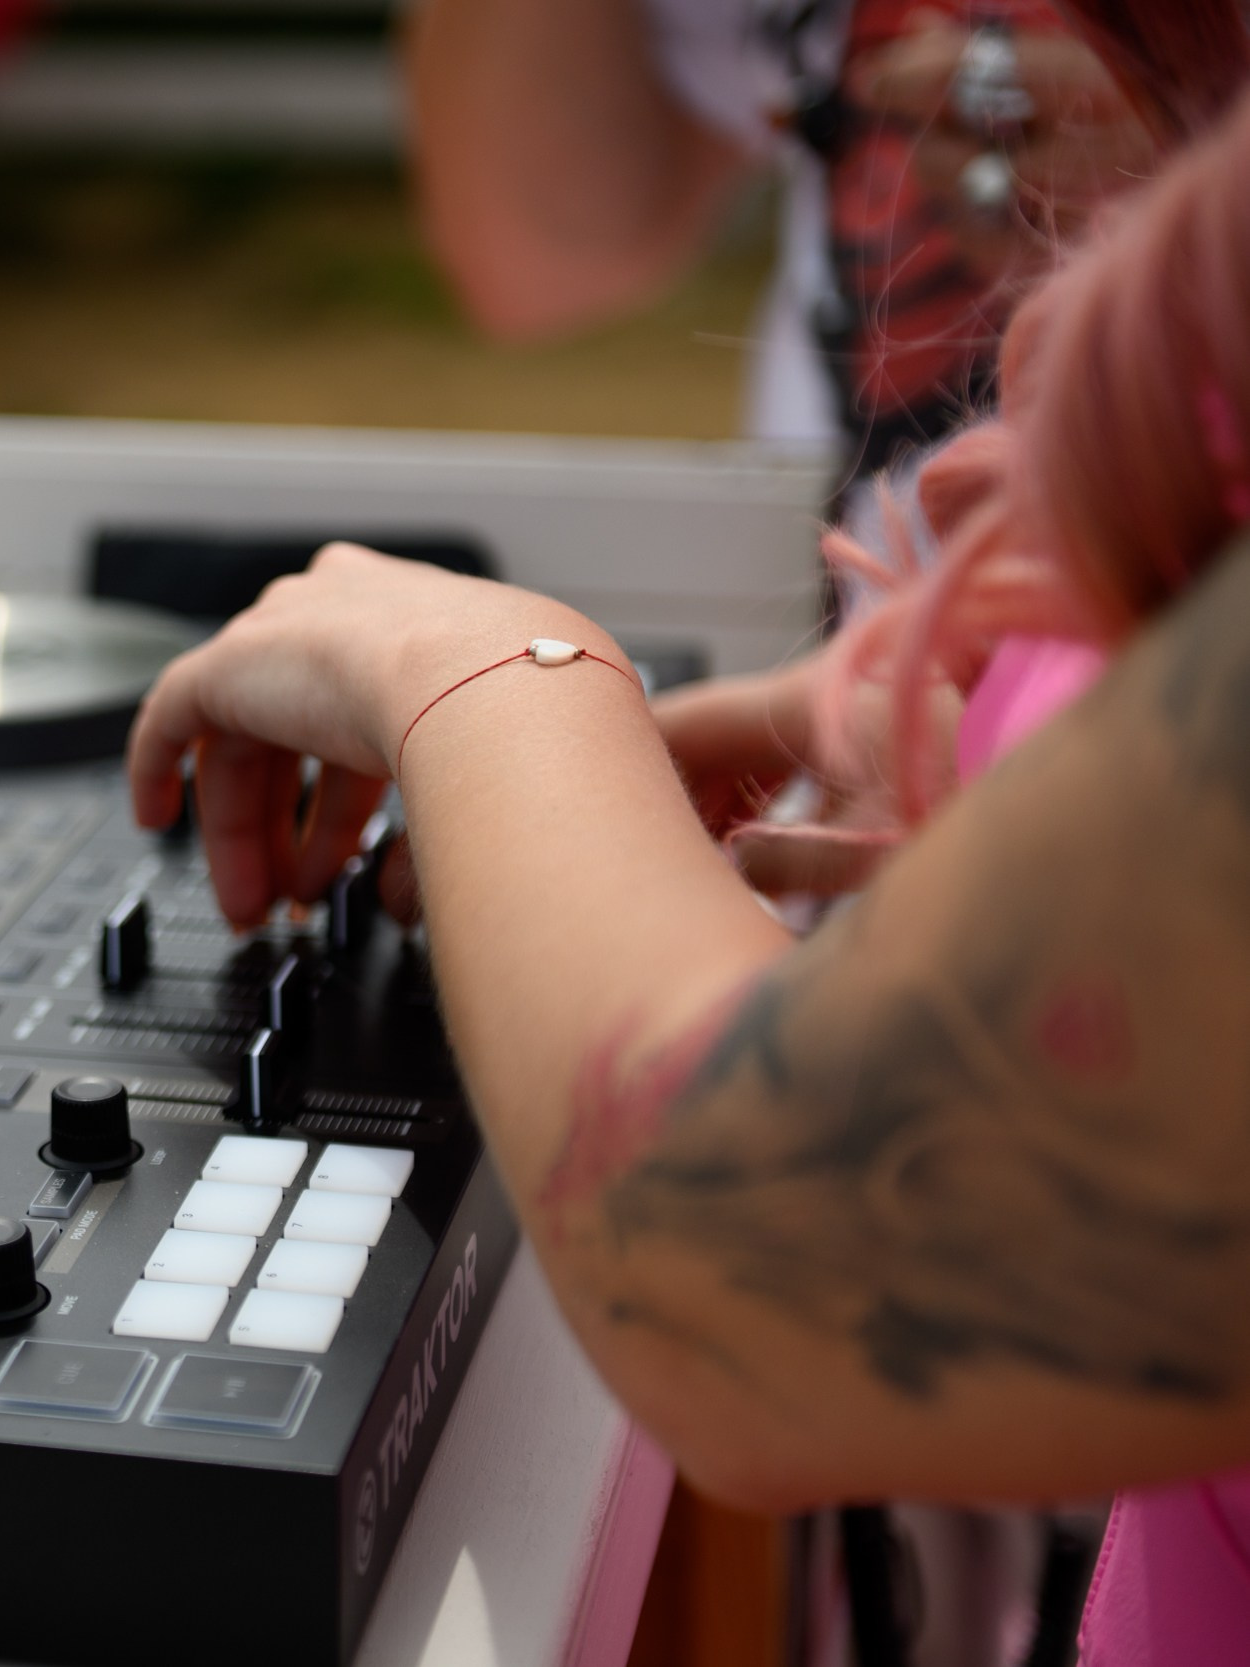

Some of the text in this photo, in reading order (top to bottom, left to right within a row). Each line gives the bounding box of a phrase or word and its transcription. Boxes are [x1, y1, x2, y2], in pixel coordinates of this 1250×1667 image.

[40, 1178, 67, 1205] SAMPLES
[70, 1209, 99, 1241] PAD MODE
[56, 1295, 79, 1316] MOVE
[379, 1232, 478, 1512] TRAKTOR
